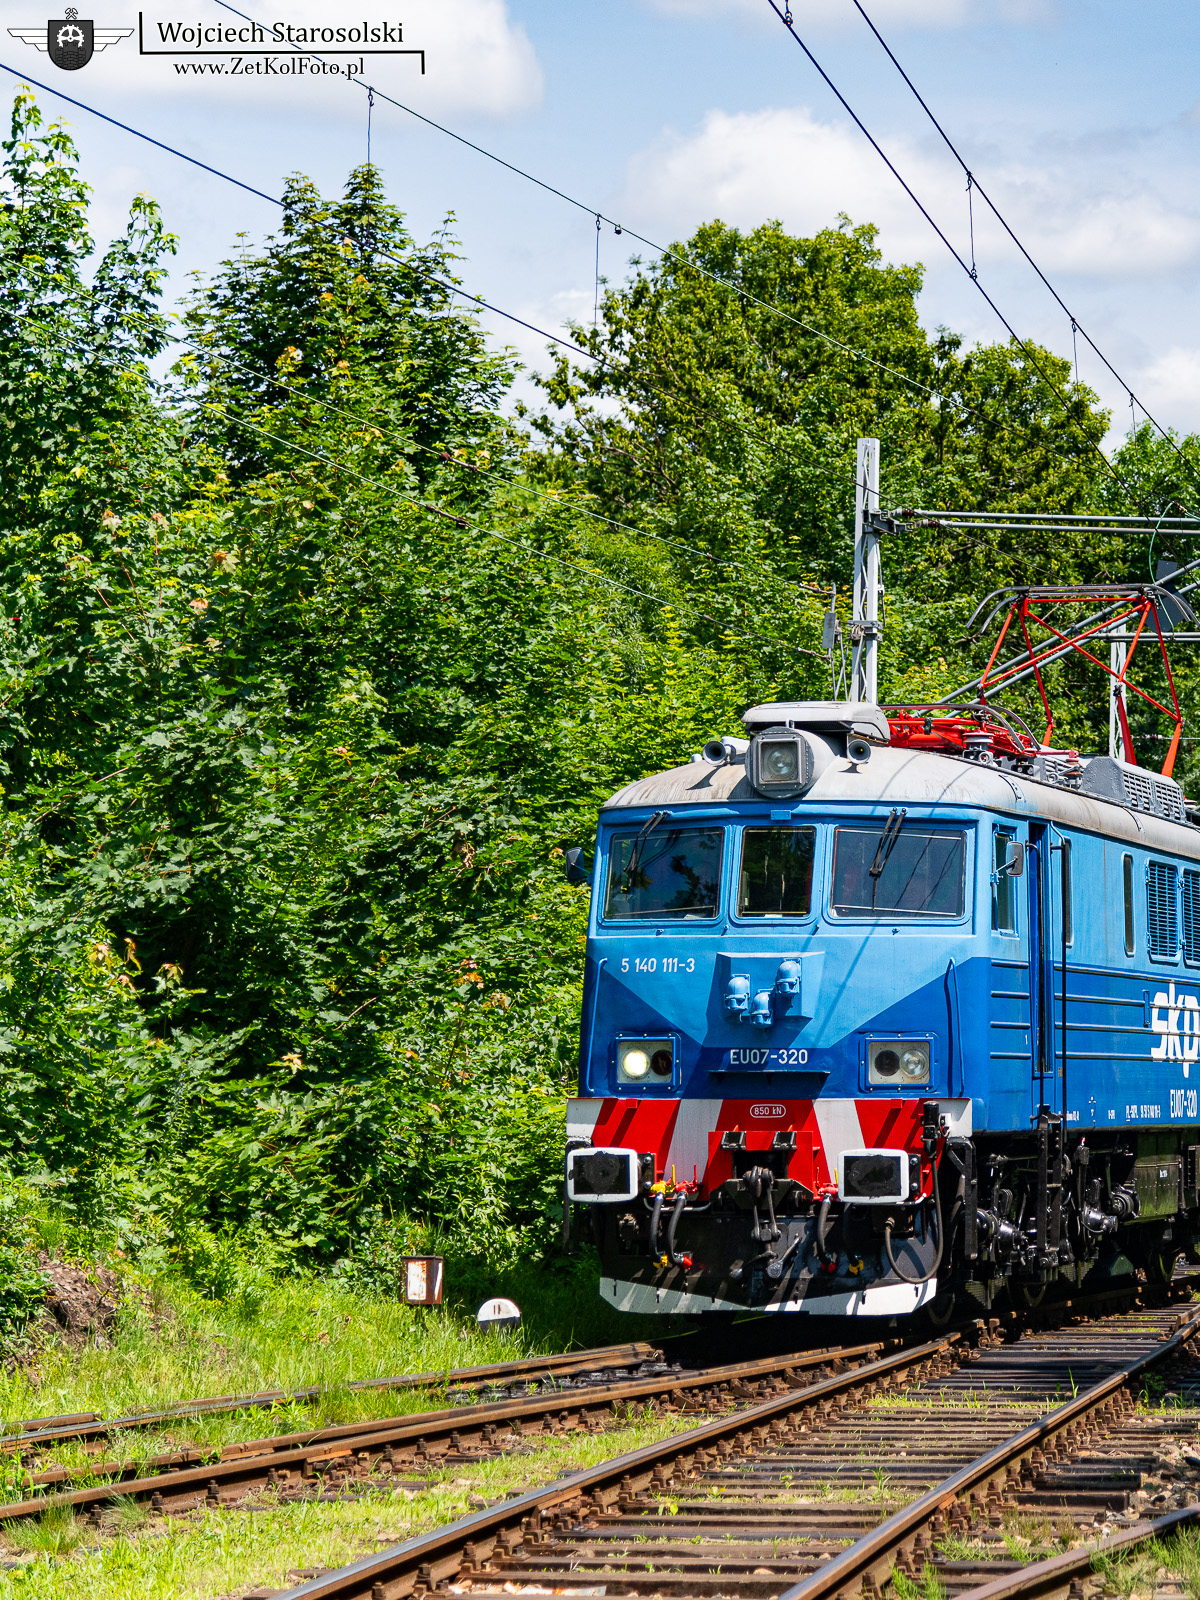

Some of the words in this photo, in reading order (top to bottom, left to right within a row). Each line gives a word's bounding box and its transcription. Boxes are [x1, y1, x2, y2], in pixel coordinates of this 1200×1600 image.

[620, 957, 629, 973] 5
[634, 957, 657, 973] 140
[662, 957, 696, 973] 111-3
[730, 1048, 808, 1065] EU07-320
[753, 1106, 770, 1116] 850
[772, 1105, 782, 1116] kN
[1169, 1088, 1198, 1118] EU07-320
